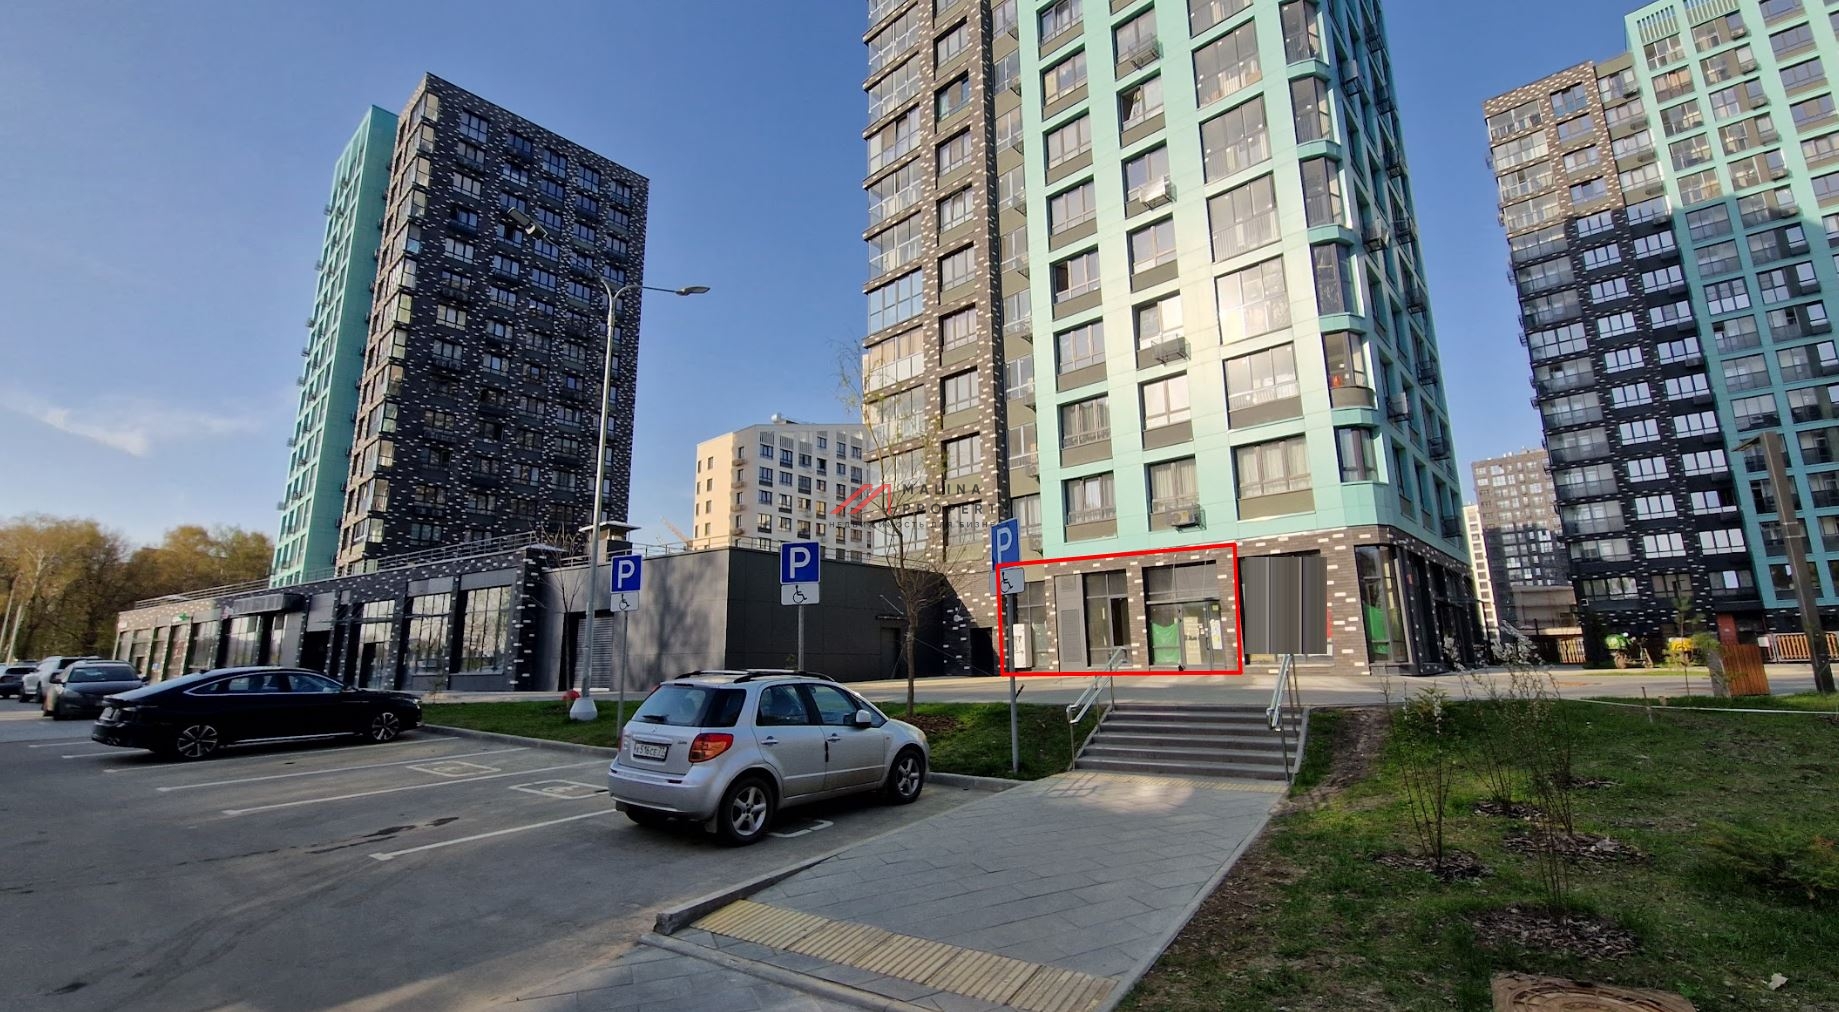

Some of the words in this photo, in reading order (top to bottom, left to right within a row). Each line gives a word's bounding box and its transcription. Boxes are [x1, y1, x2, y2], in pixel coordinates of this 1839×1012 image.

[997, 527, 1012, 564] P
[617, 560, 635, 589] P
[790, 547, 811, 579] P
